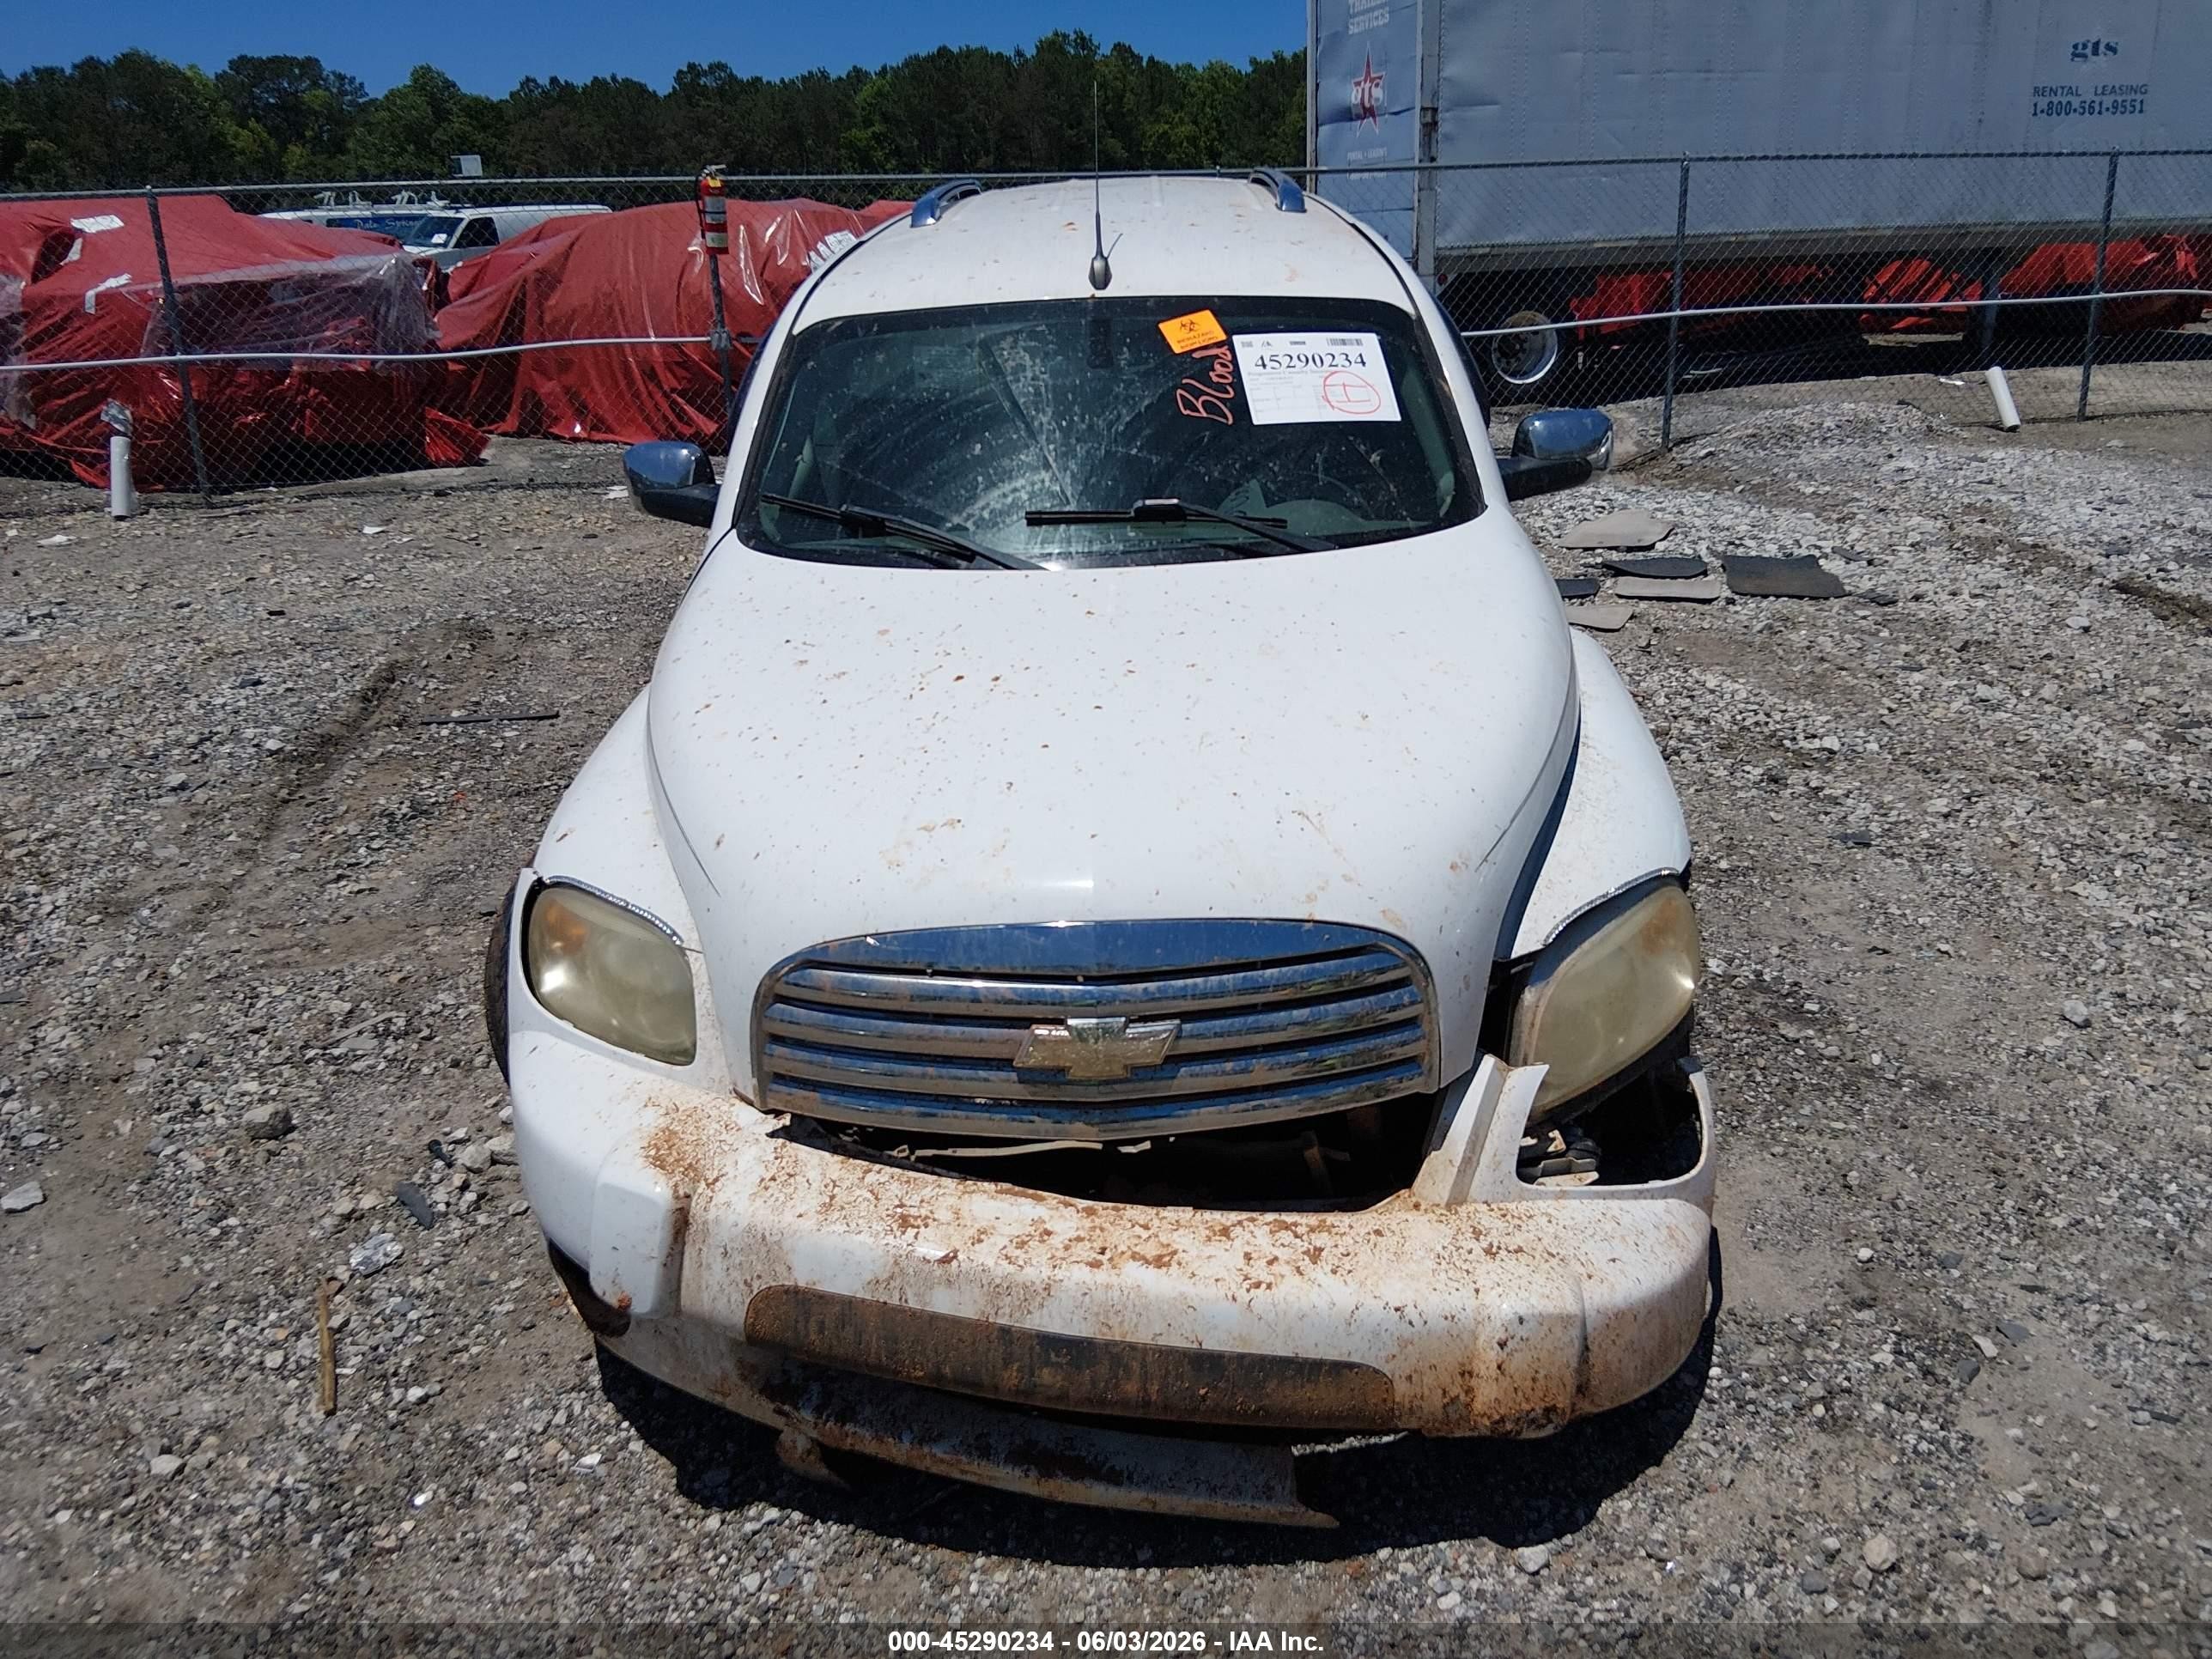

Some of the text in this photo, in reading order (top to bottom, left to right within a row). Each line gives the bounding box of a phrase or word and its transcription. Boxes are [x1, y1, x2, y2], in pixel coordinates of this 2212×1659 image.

[1348, 7, 1389, 34] SERVICES
[2070, 38, 2118, 62] gts
[2033, 84, 2148, 97] RENTAL LEASING
[1255, 352, 1367, 370] 45290234
